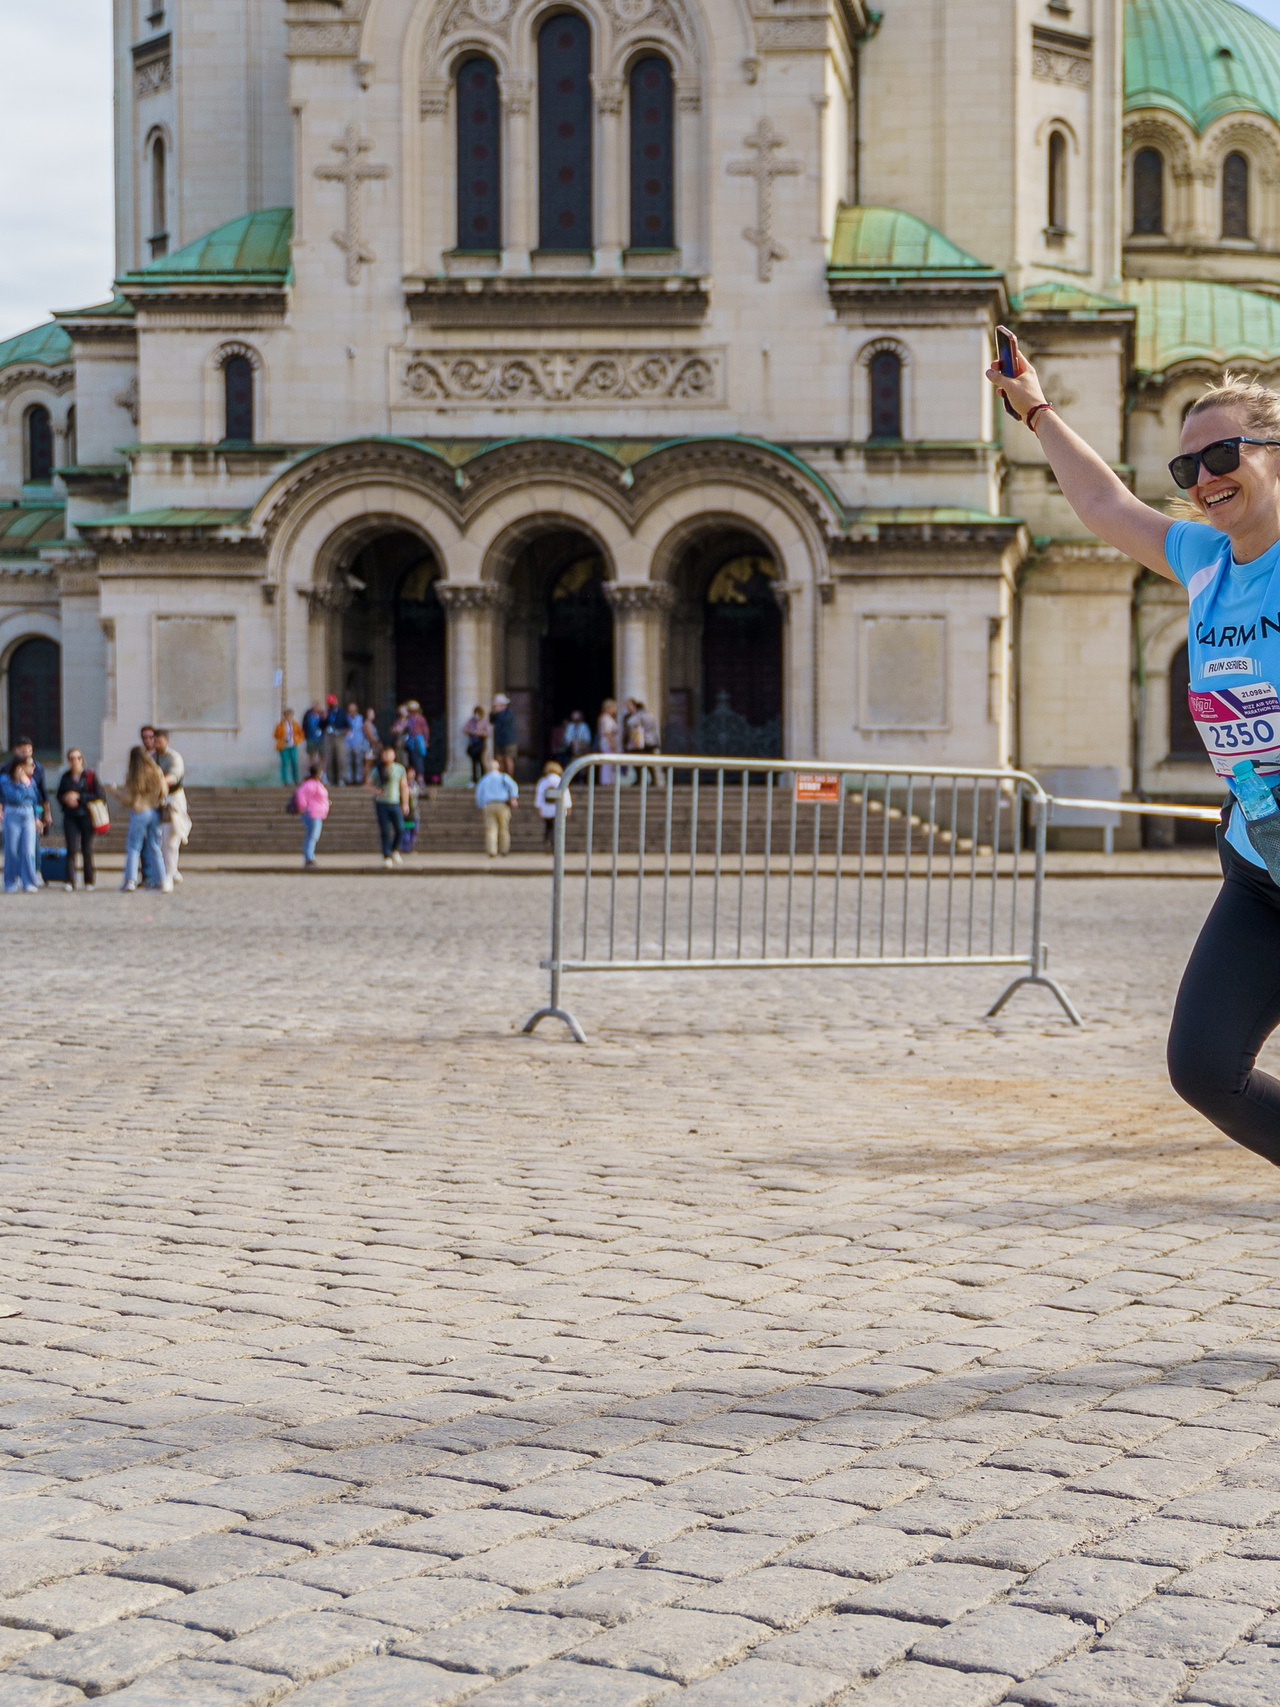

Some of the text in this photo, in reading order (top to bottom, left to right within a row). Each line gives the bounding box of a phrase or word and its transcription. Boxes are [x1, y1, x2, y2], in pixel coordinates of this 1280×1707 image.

[1208, 661, 1225, 673] RUN
[1241, 688, 1263, 698] 21.098
[1209, 719, 1274, 748] 2350
